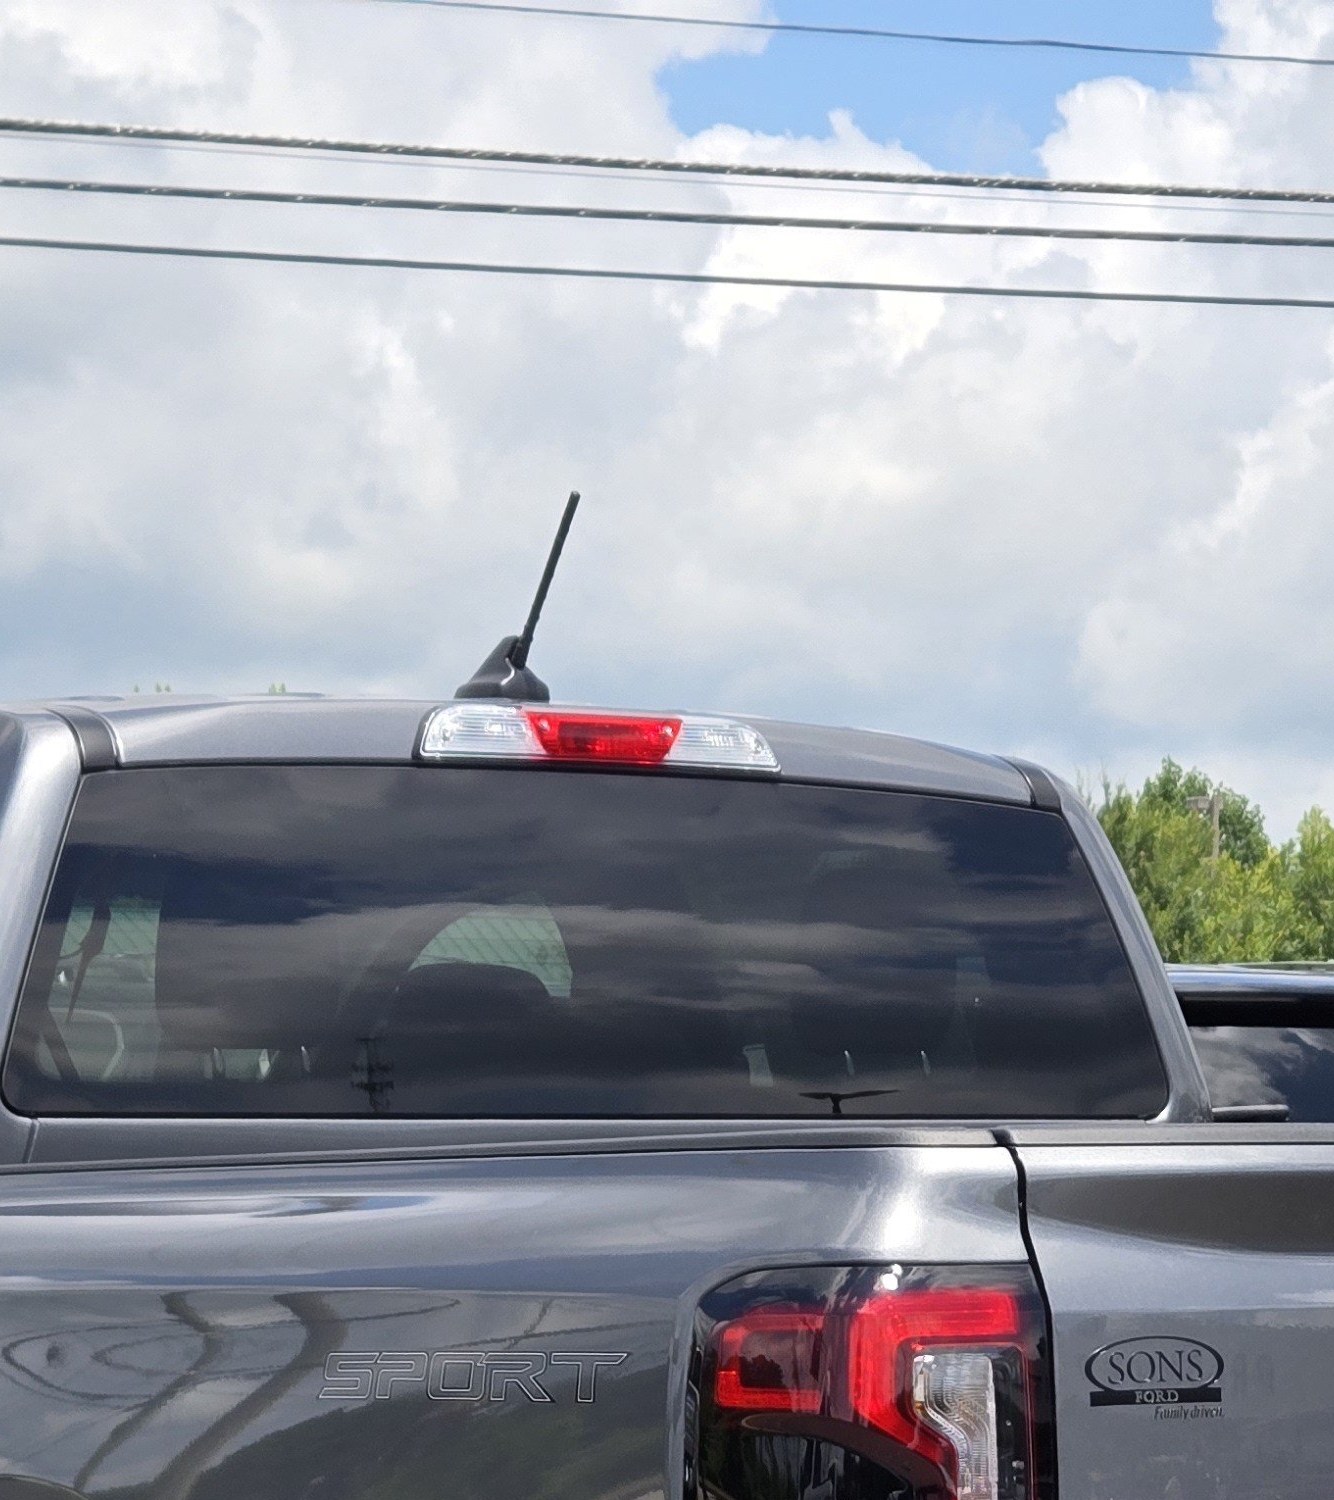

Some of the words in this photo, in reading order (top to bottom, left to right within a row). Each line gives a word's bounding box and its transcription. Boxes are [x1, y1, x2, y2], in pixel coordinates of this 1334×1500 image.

[318, 1351, 629, 1403] SPORT
[1107, 1349, 1203, 1385] SONS
[1135, 1389, 1179, 1404] FORD
[1154, 1406, 1191, 1421] Family
